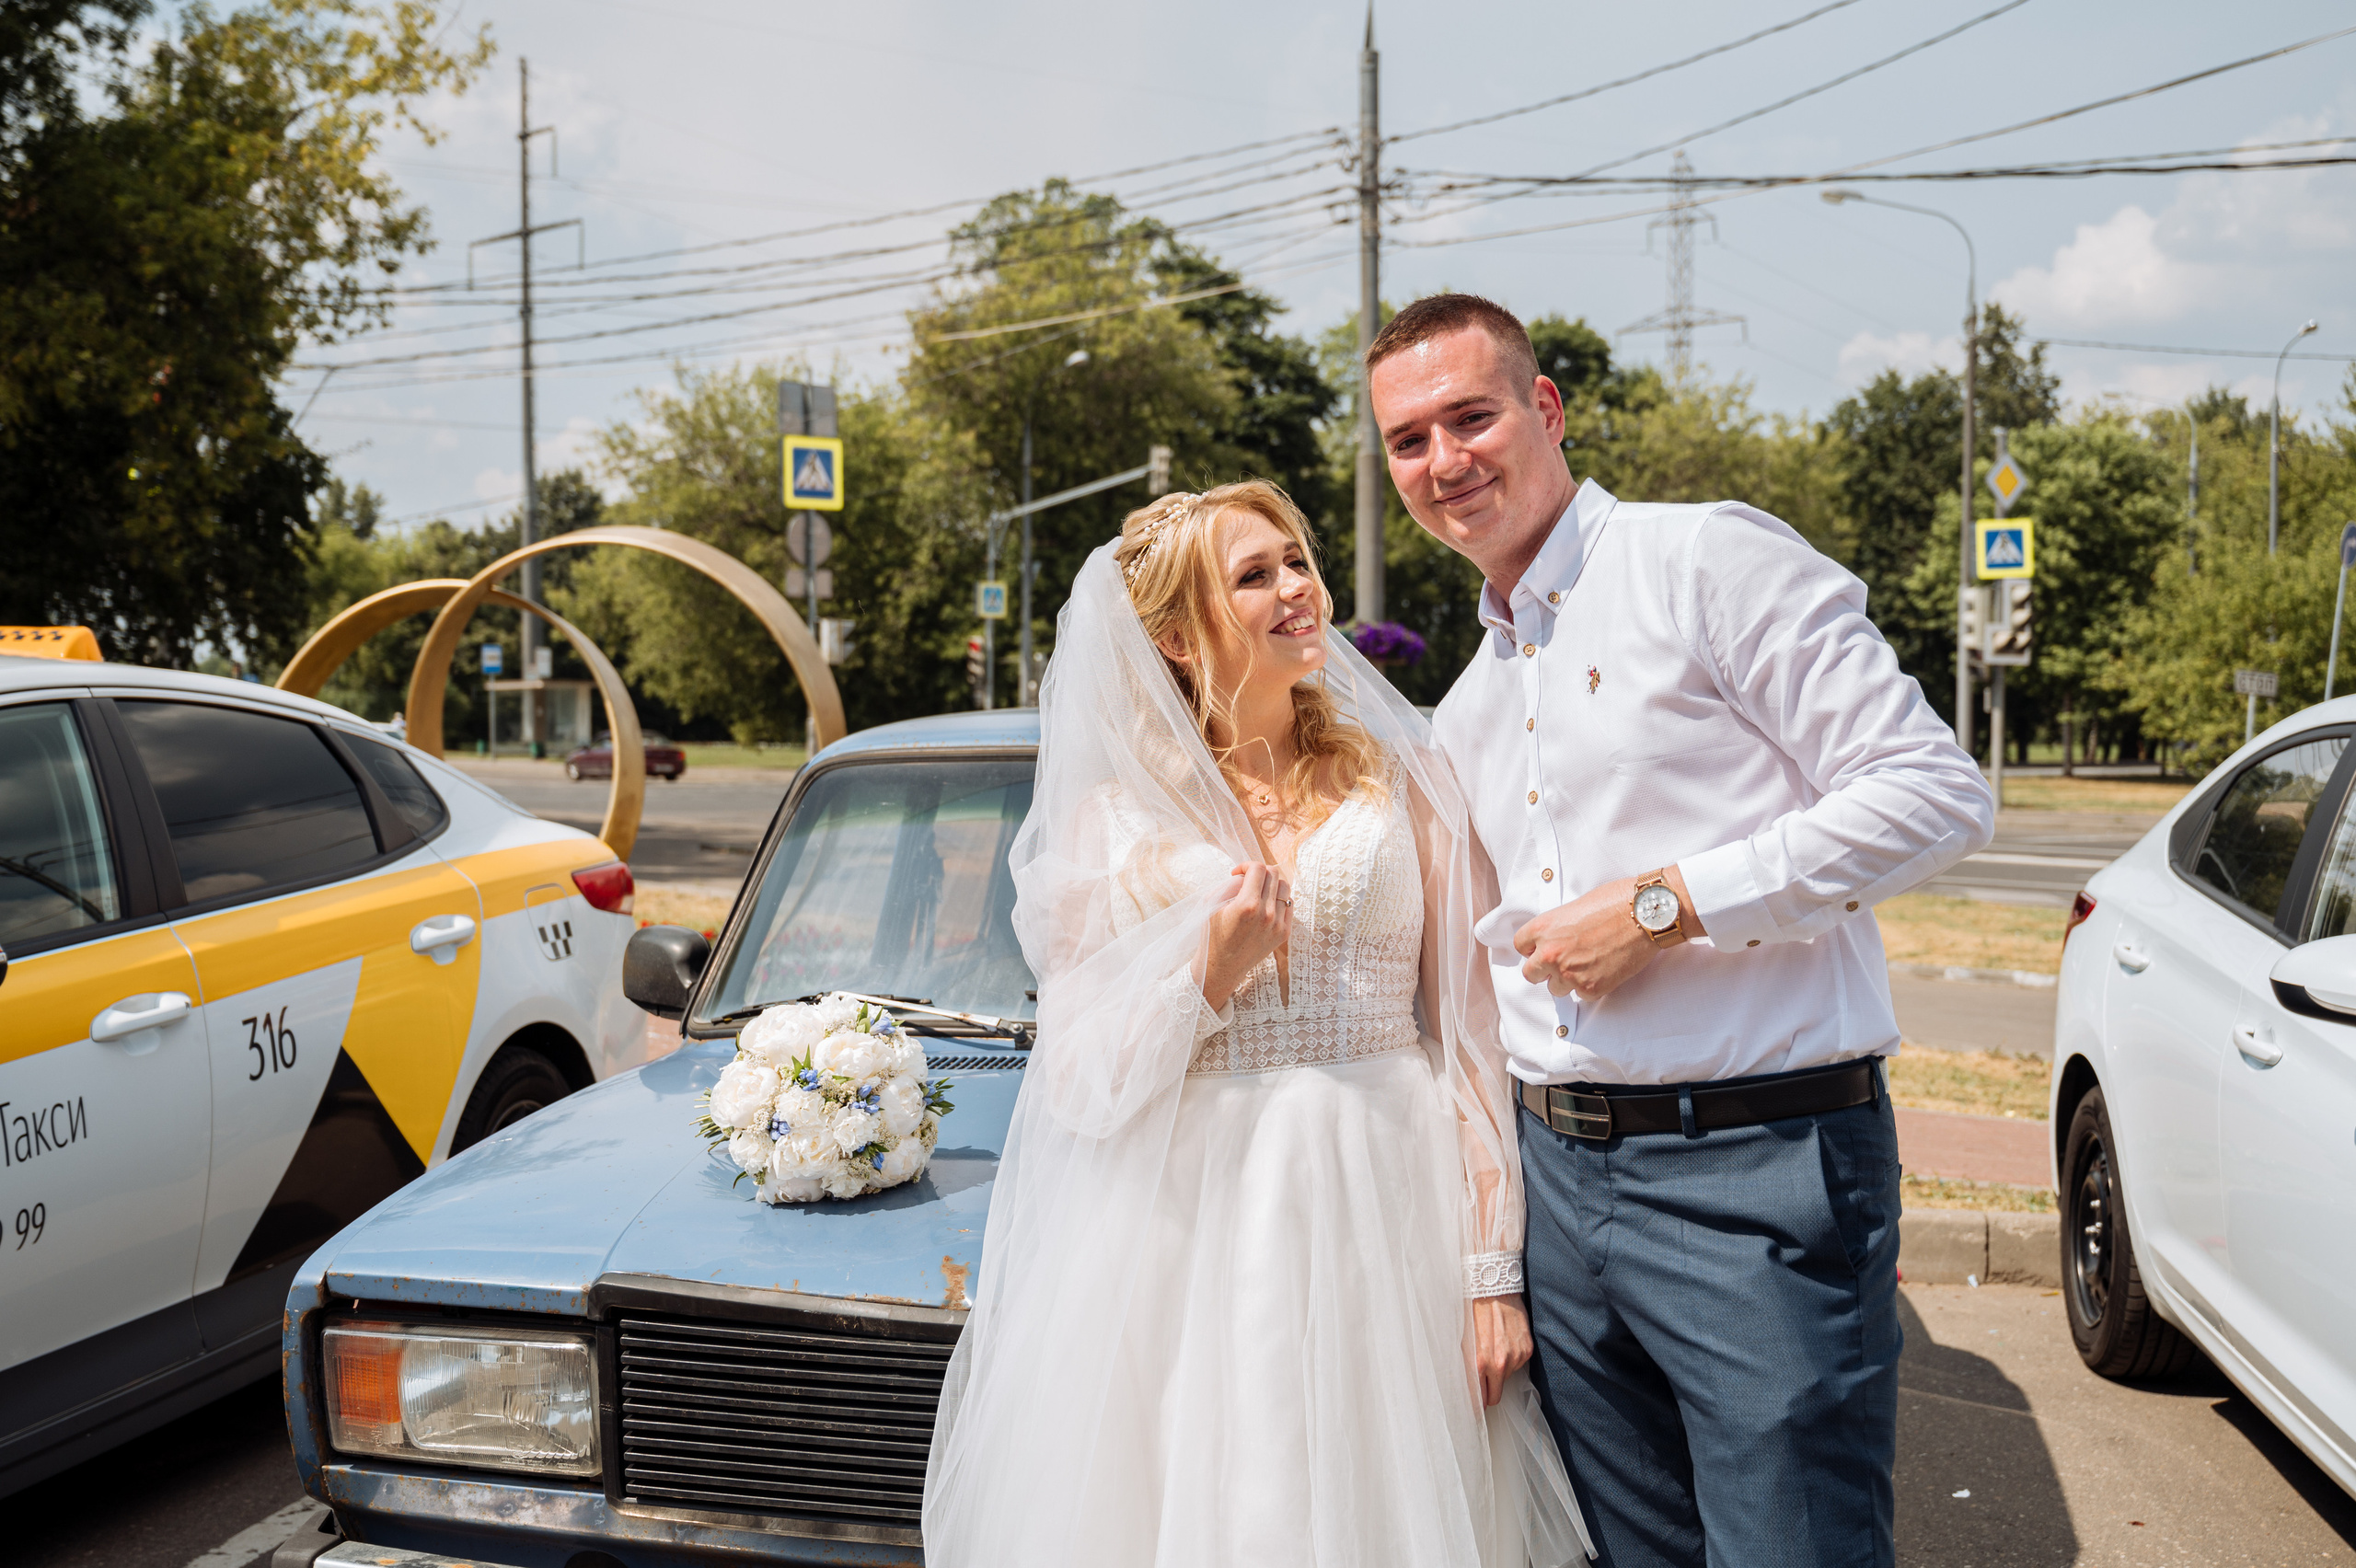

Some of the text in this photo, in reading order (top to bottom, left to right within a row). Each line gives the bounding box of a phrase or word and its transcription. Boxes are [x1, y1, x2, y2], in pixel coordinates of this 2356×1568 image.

[241, 1005, 296, 1081] 316
[0, 1096, 87, 1167] Такси
[16, 1202, 45, 1251] 99
